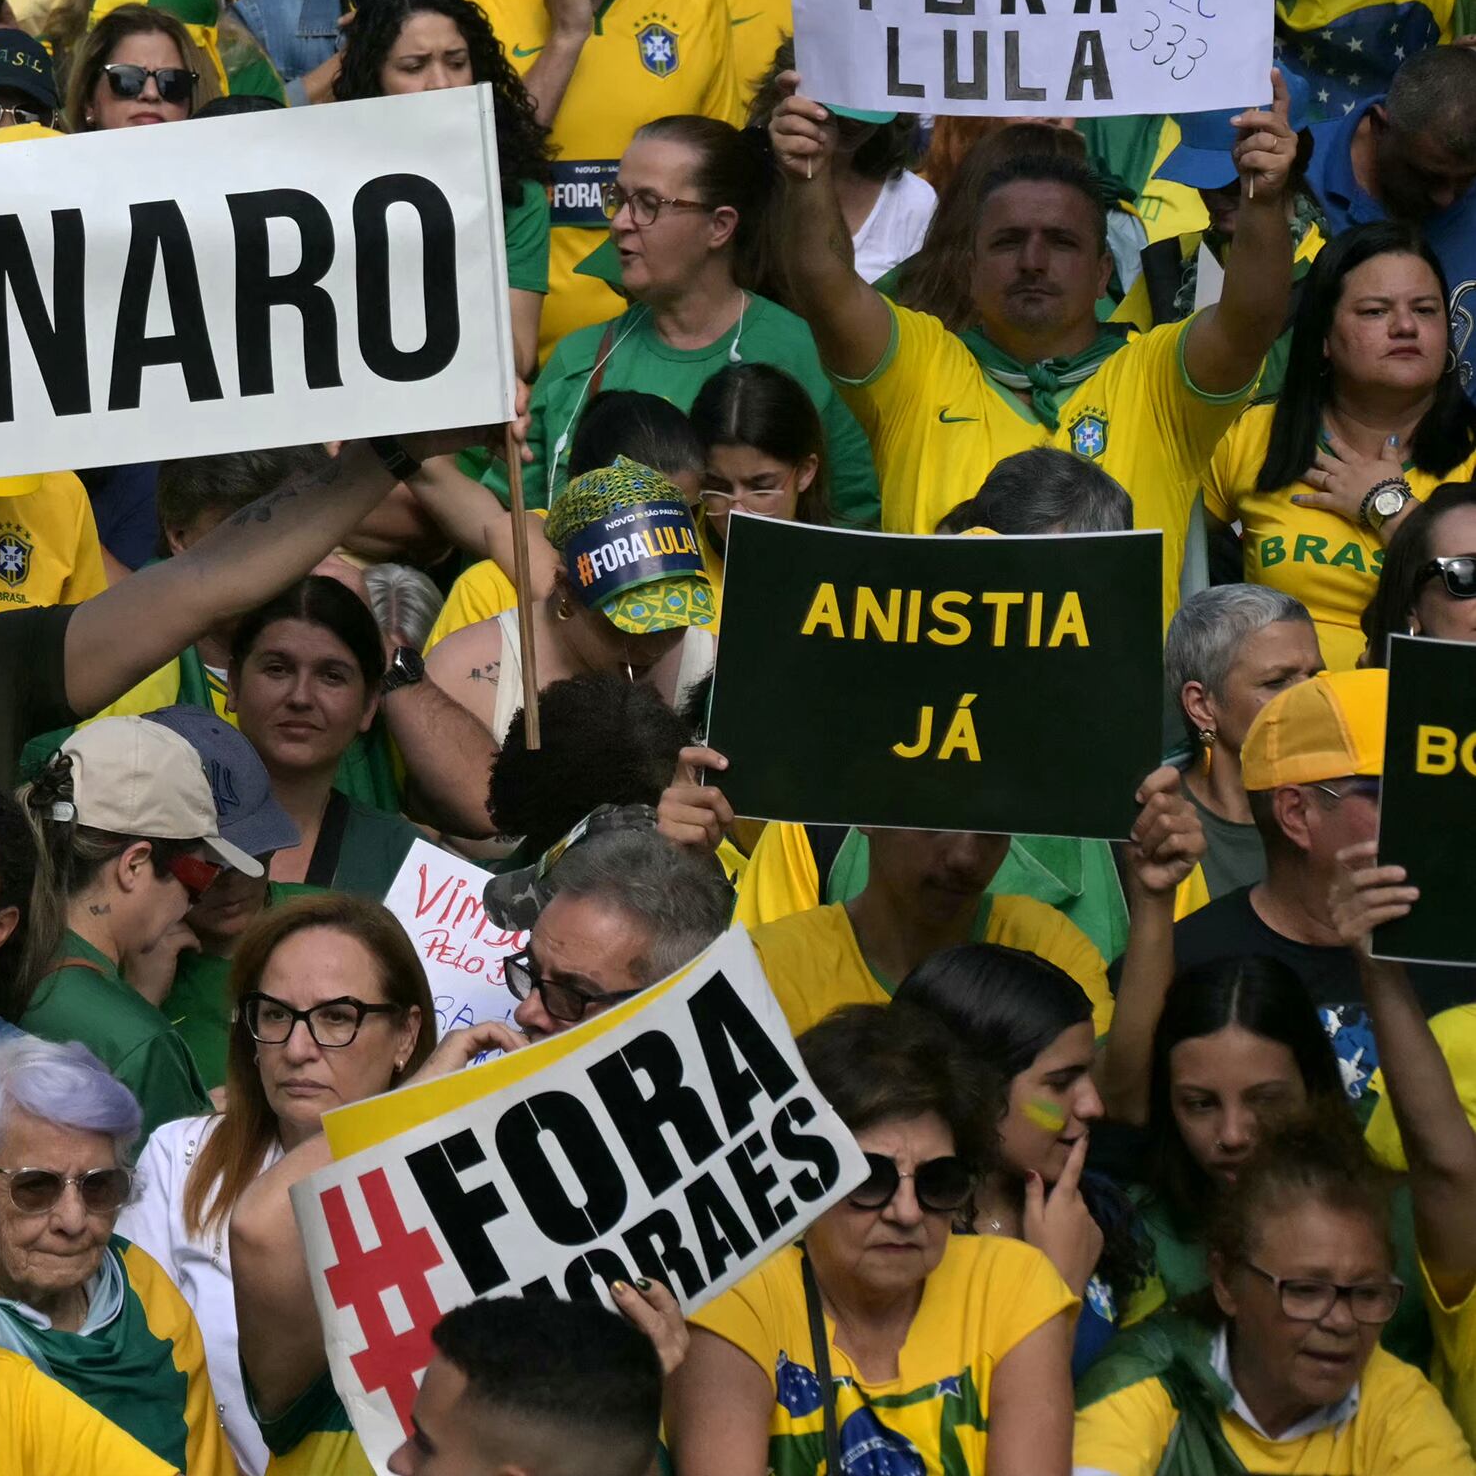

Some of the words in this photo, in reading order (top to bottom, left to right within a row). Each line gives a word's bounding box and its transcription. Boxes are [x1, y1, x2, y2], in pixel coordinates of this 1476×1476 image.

[885, 25, 1114, 102] LULA
[1129, 10, 1209, 82] 333
[576, 525, 700, 588] #FORALULA!
[604, 513, 636, 532] NOVO
[801, 581, 1091, 649] ANISTIA
[891, 692, 984, 763] JÁ
[404, 969, 801, 1298] FORA
[527, 1094, 851, 1316] ORAES
